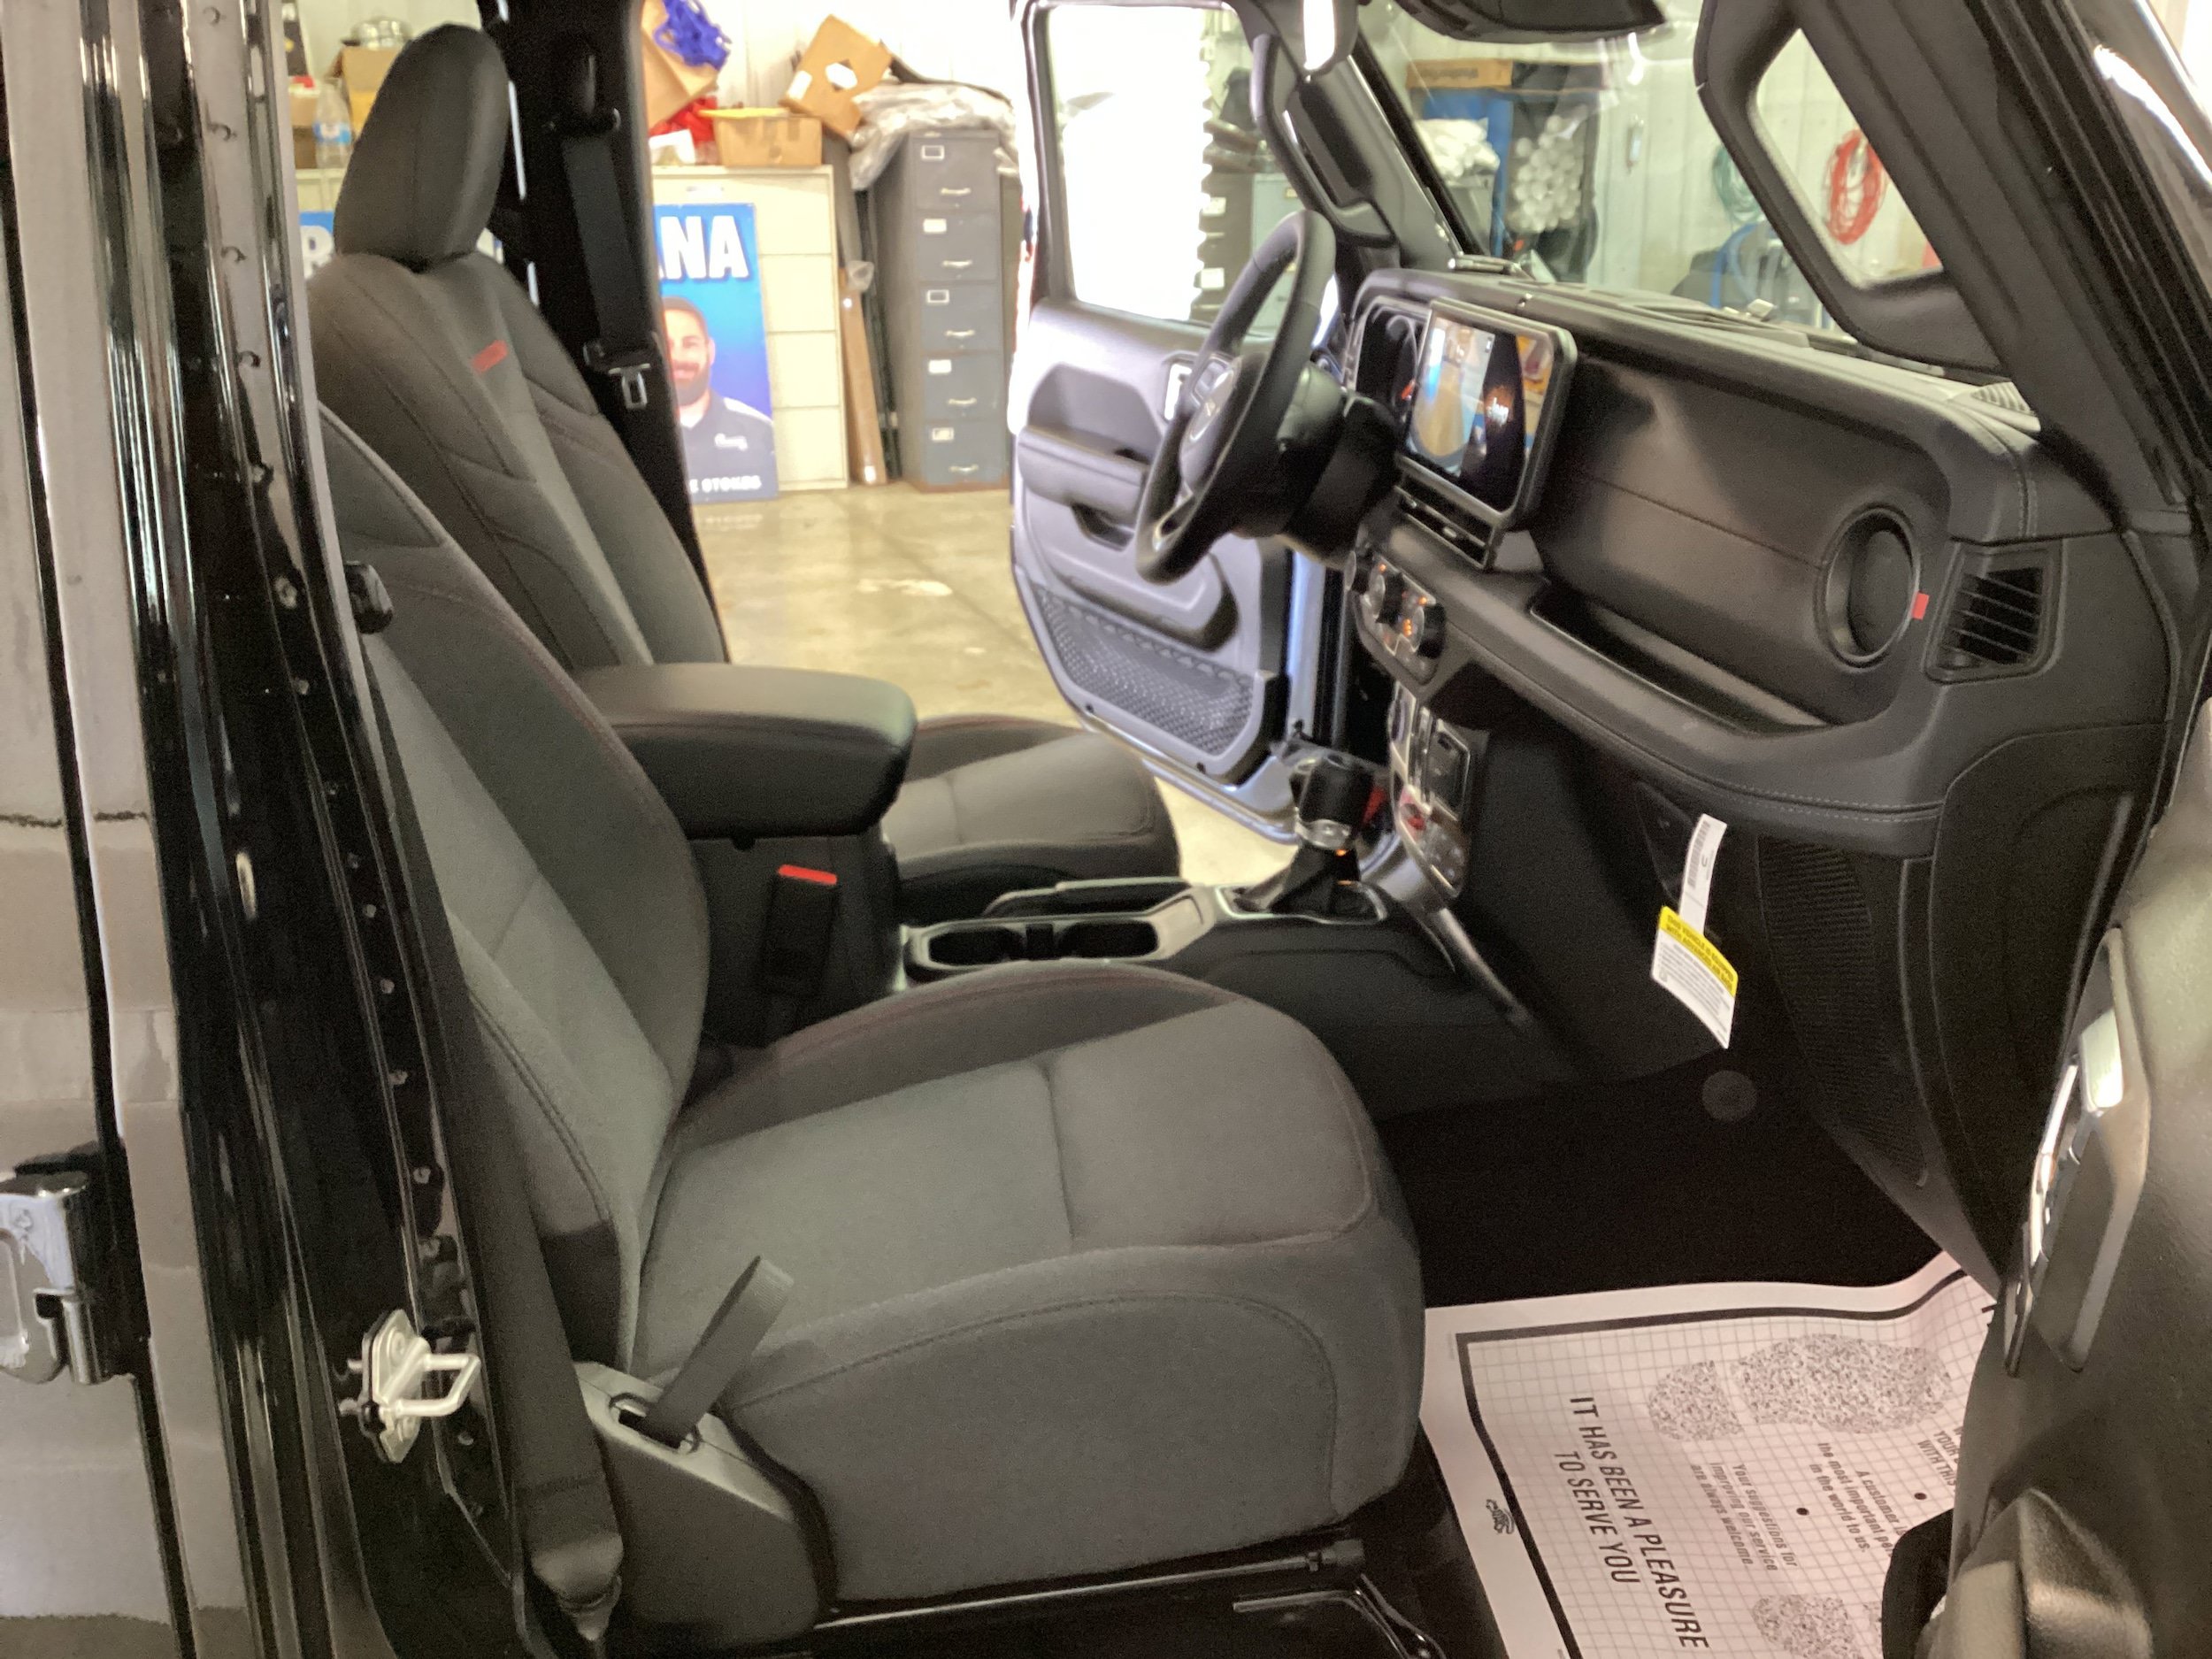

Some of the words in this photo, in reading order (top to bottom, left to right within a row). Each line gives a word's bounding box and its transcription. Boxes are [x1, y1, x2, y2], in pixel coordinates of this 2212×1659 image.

[659, 215, 749, 280] NA
[1570, 1397, 1599, 1417] IT
[1554, 1451, 1586, 1472] TO
[1578, 1426, 1618, 1460] HAS
[1917, 1440, 1946, 1464] WITH
[1567, 1479, 1618, 1536] SERVE
[1599, 1466, 1645, 1510] BEEN
[1816, 1475, 1834, 1492] the
[1828, 1494, 1856, 1521] world
[1847, 1524, 1861, 1534] to
[1817, 1442, 1834, 1458] the
[1828, 1461, 1854, 1485] most
[1844, 1486, 1886, 1534] important
[1862, 1479, 1900, 1524] customer
[1624, 1516, 1653, 1528] A
[1690, 1464, 1709, 1480] are
[1701, 1483, 1728, 1514] always
[1721, 1517, 1754, 1565] welcome
[1732, 1463, 1752, 1486] Your
[1745, 1489, 1787, 1549] suggestions
[1780, 1552, 1798, 1567] for
[1598, 1542, 1640, 1584] YOU
[1739, 1512, 1756, 1529] our
[1749, 1532, 1778, 1571] service
[1633, 1534, 1709, 1648] PLEASURE
